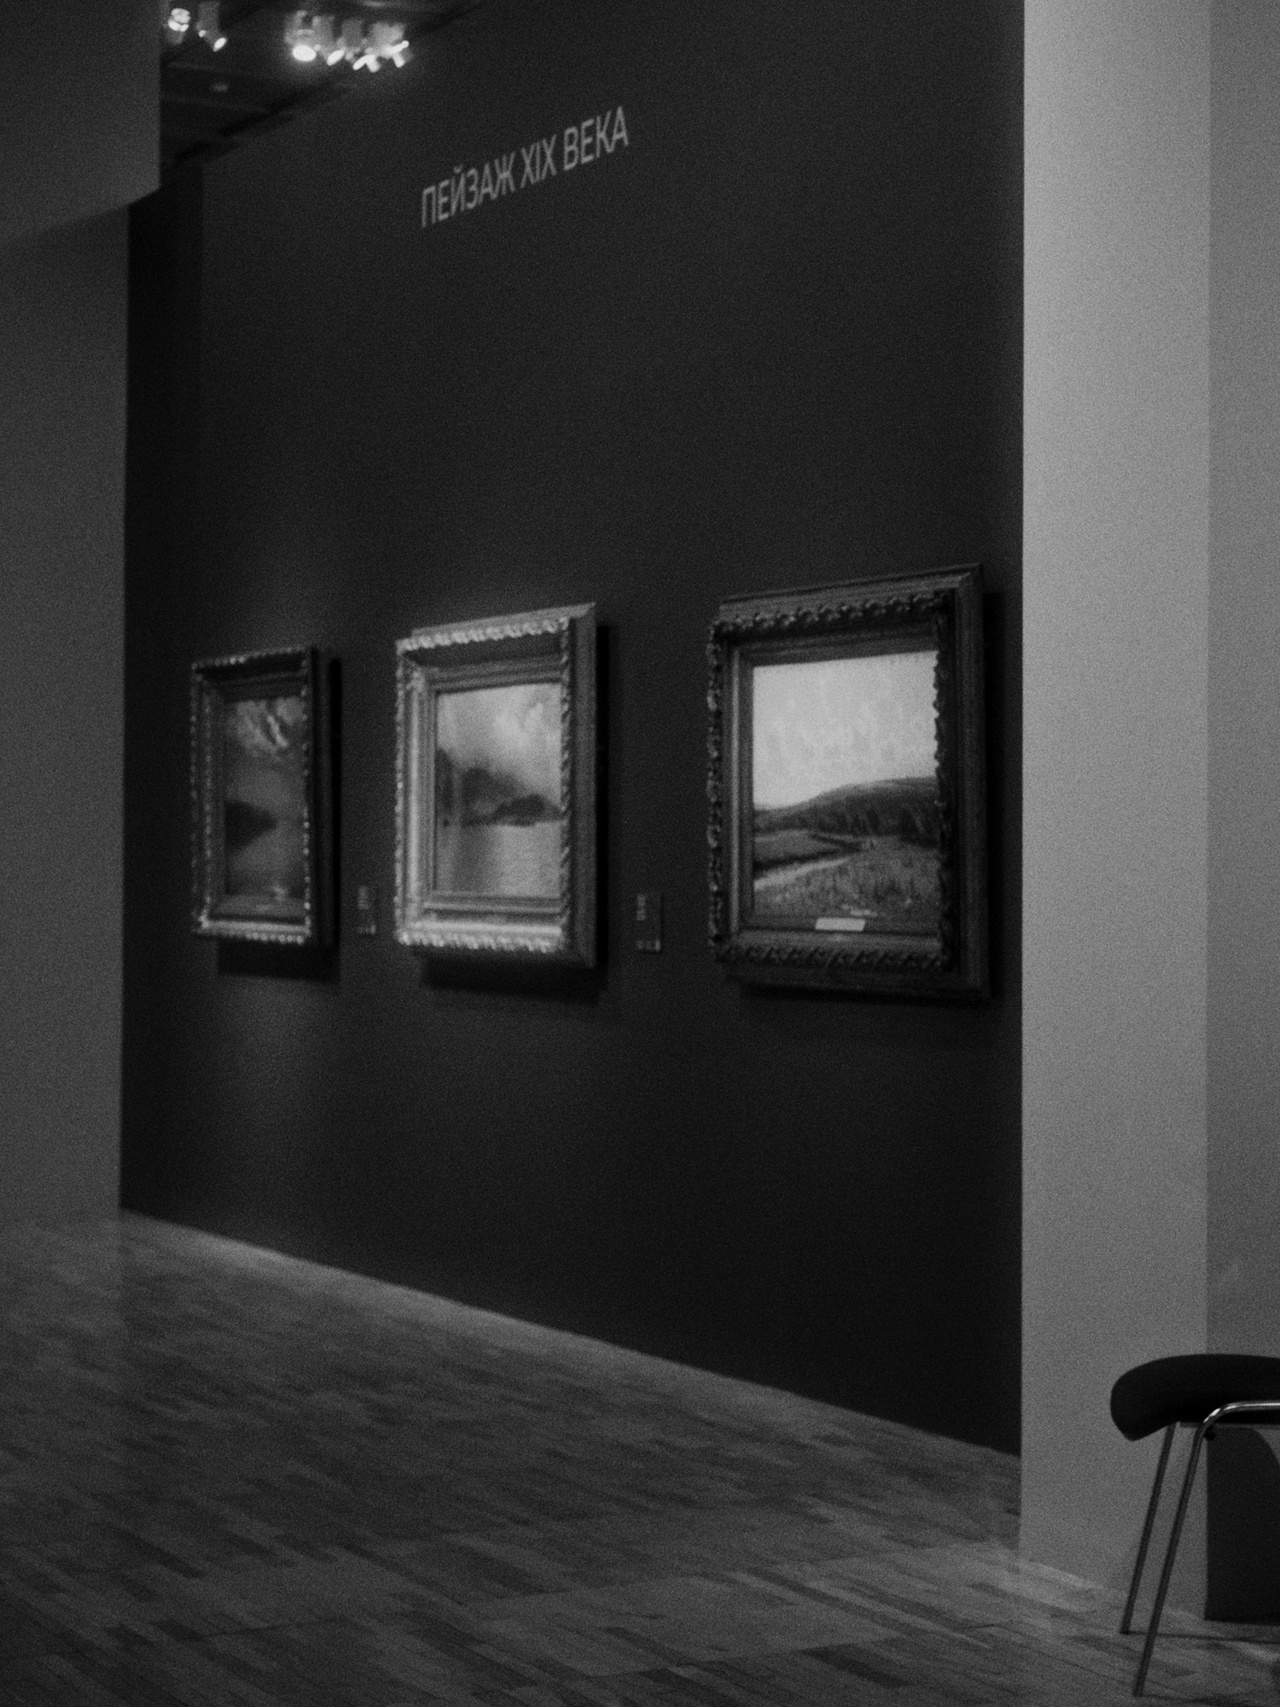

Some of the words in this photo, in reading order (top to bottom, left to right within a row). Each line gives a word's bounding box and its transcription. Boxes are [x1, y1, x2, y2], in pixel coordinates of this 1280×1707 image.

[421, 152, 515, 228] ПЕЙЗАЖ
[520, 134, 557, 189] XIX
[564, 106, 629, 171] ВЕКА
